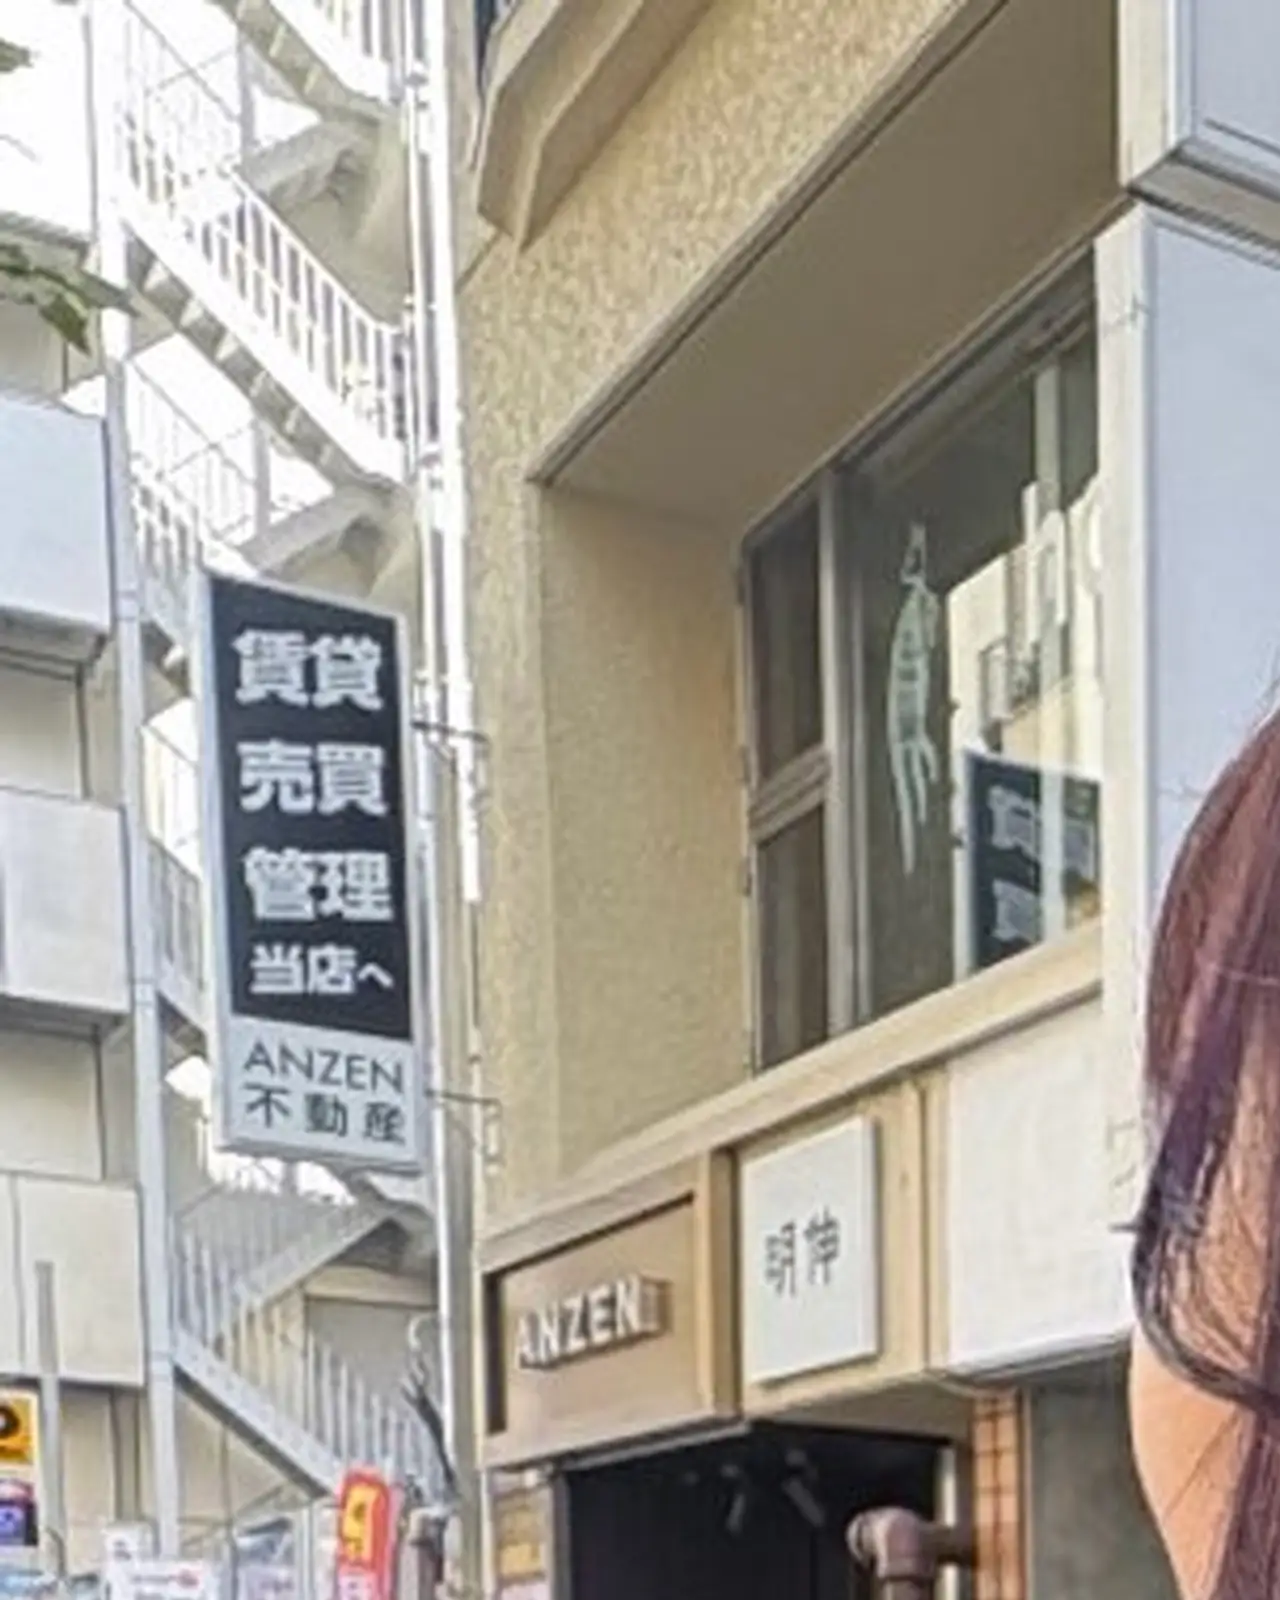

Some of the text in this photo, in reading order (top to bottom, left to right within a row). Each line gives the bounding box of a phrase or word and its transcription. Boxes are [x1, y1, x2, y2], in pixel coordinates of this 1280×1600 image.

[232, 629, 382, 709] 賃貸
[237, 739, 387, 815] 売買
[242, 847, 395, 922] 管理
[249, 943, 394, 994] 当店へ
[243, 1036, 404, 1094] ANZEN
[241, 1081, 407, 1146] 不動産
[516, 1274, 643, 1366] ANZEN
